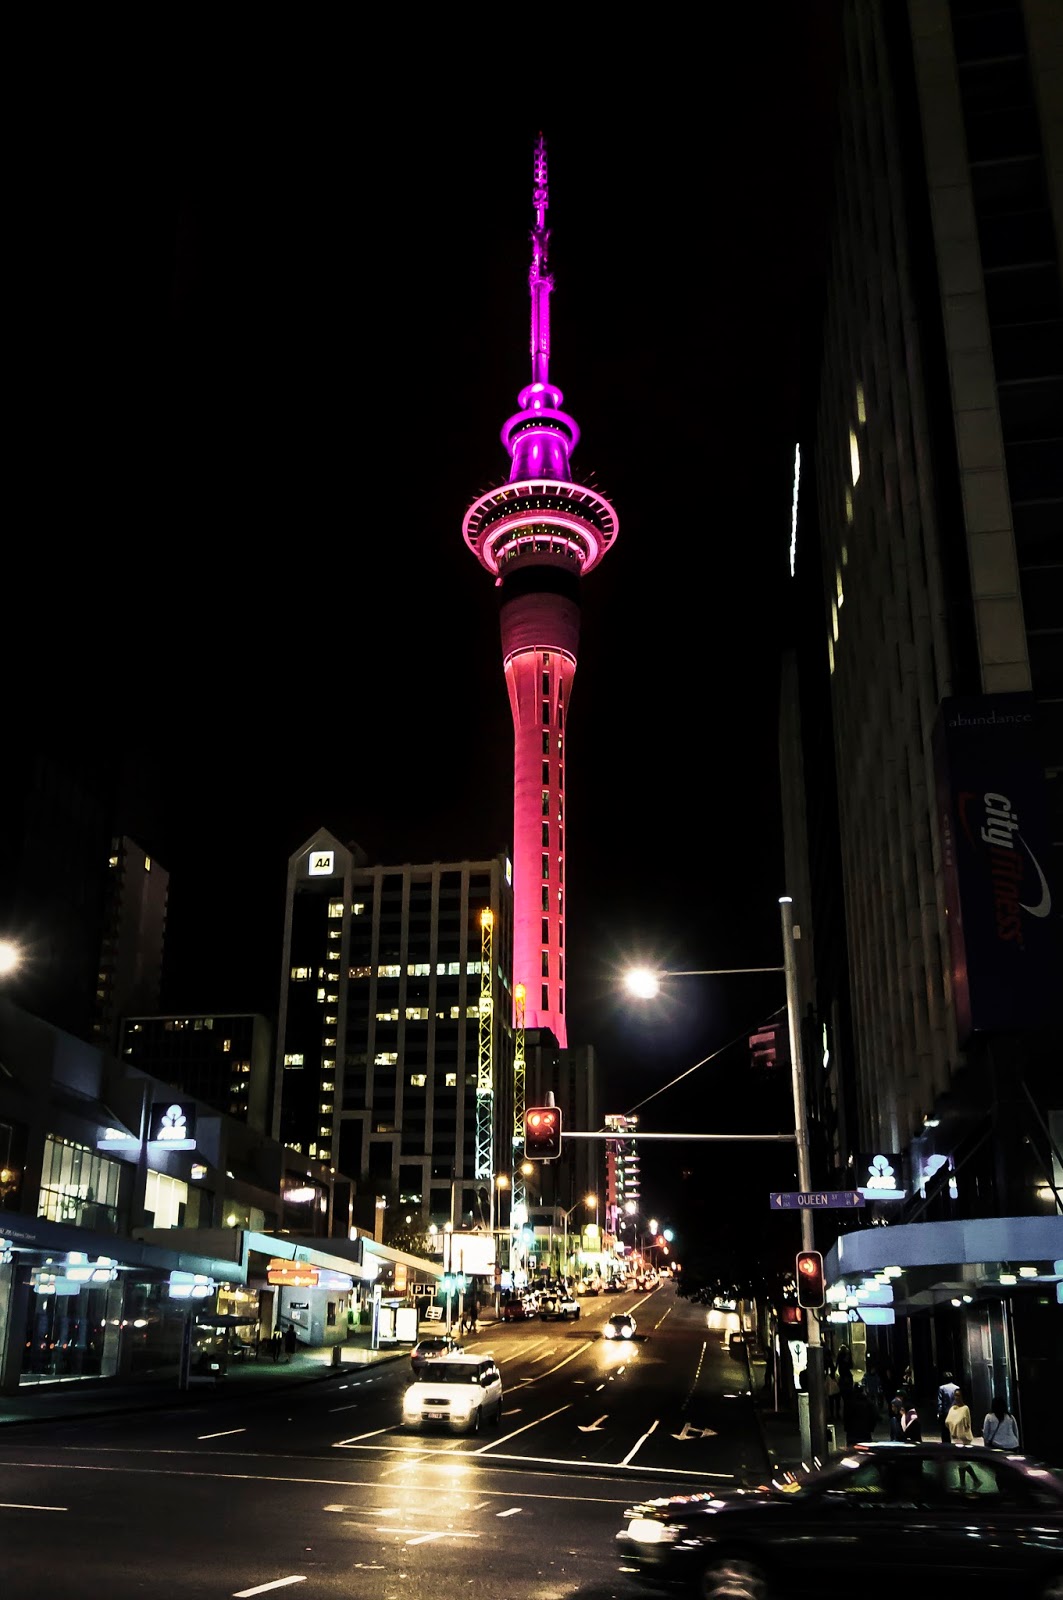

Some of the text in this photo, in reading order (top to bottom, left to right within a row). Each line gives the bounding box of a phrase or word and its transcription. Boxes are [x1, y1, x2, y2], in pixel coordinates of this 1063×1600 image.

[949, 710, 1033, 728] abundance
[315, 858, 330, 868] AA
[798, 1194, 828, 1206] QUEEN
[415, 1285, 422, 1294] P
